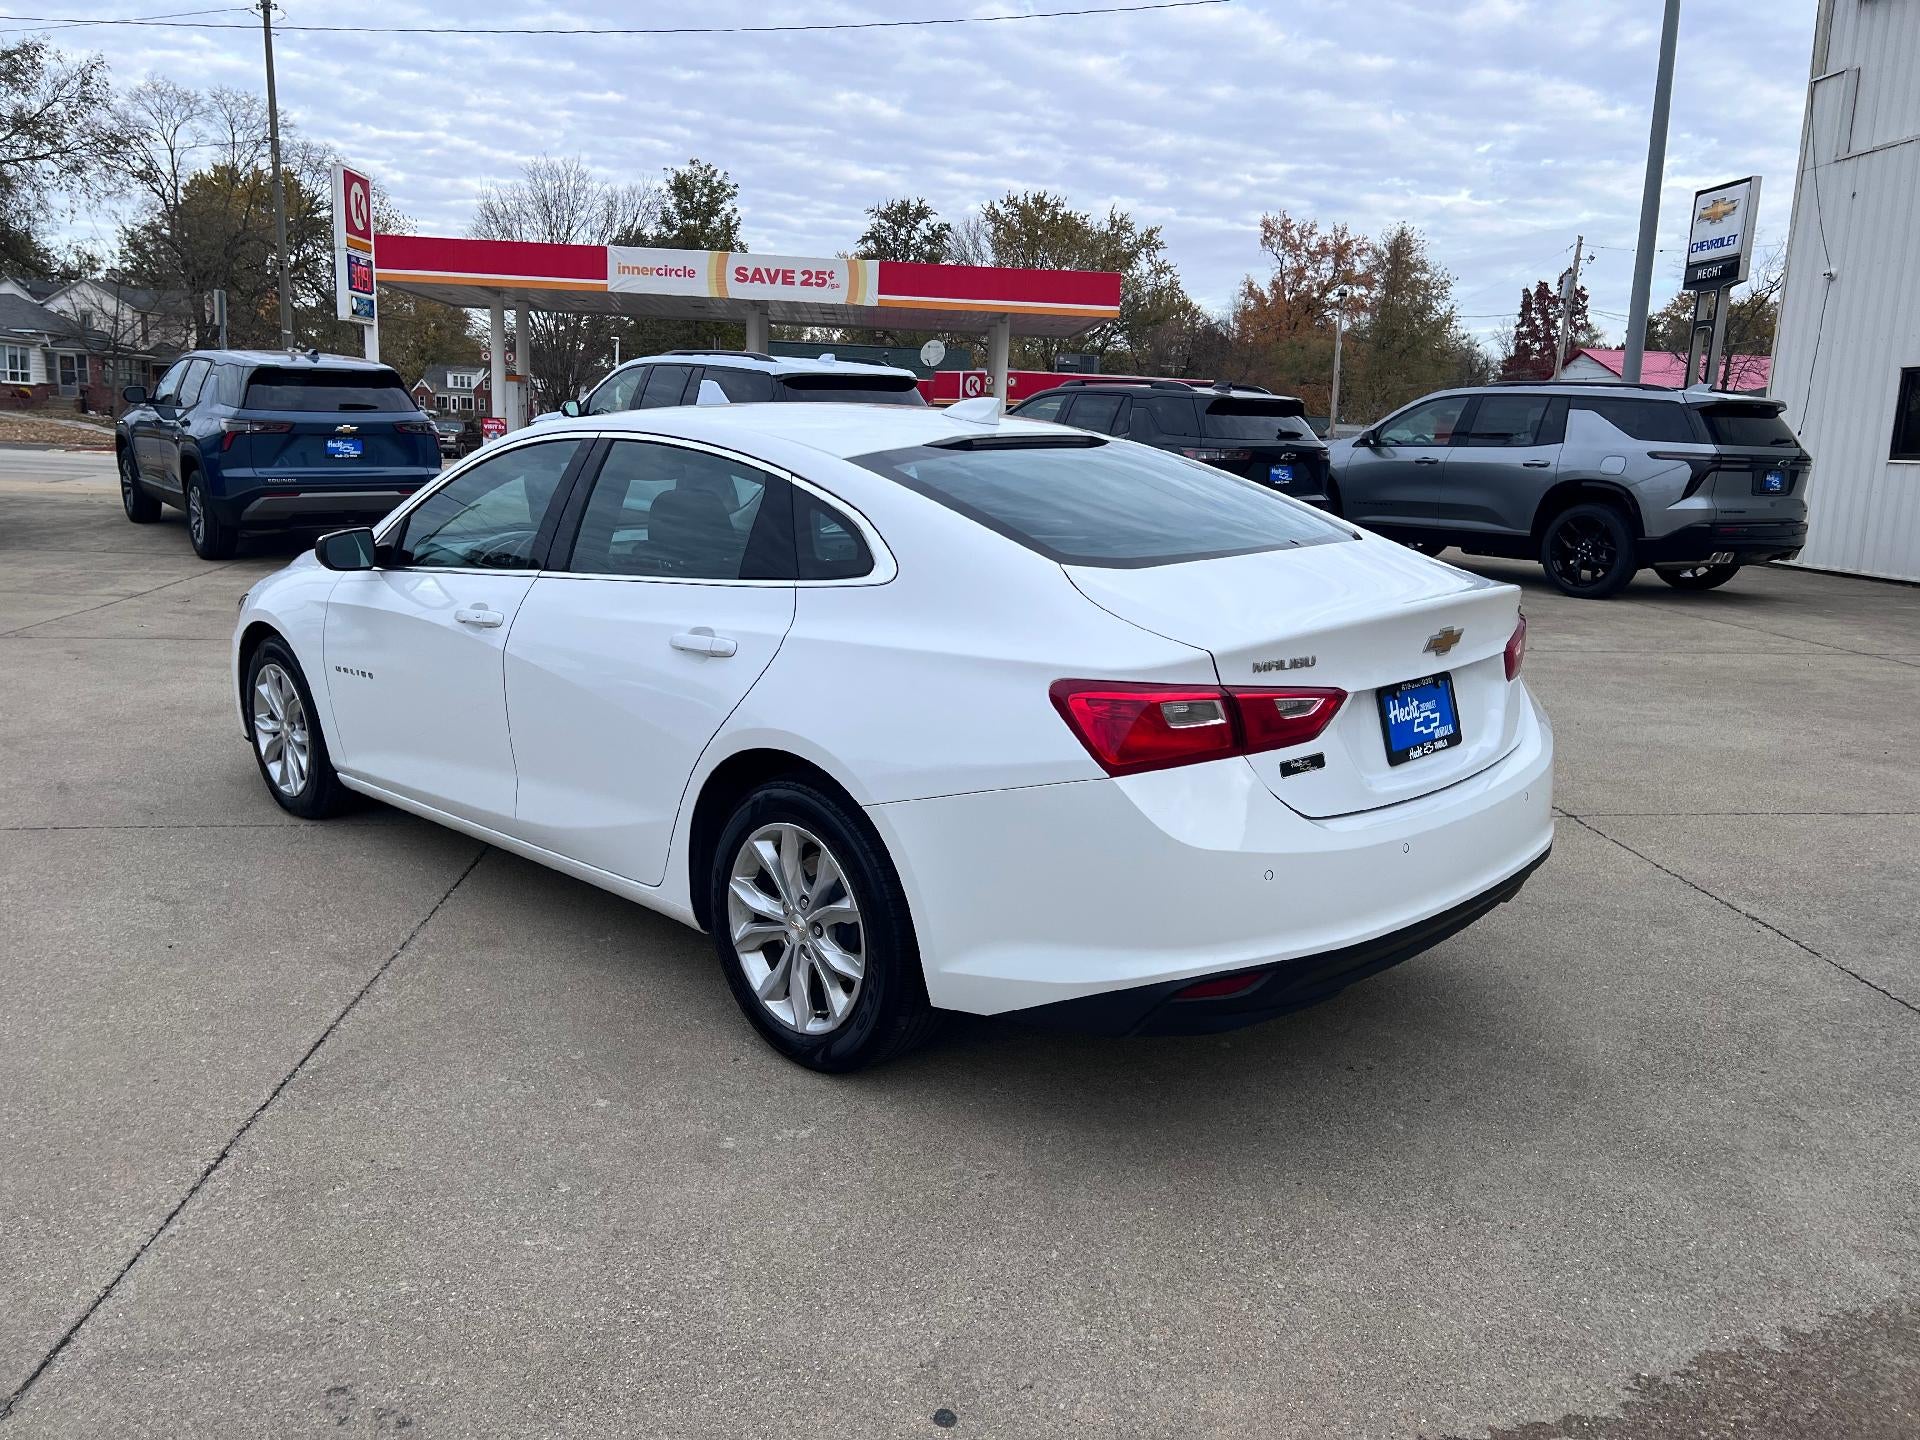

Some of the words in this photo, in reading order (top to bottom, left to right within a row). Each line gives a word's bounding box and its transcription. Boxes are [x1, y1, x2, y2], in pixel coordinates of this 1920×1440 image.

[1691, 233, 1738, 254] CHEVROLET
[617, 262, 697, 279] innercircle
[734, 266, 796, 286] SAVE
[1696, 265, 1723, 279] HECHT
[1252, 655, 1317, 674] MALIBU
[1388, 696, 1420, 725] Hecht
